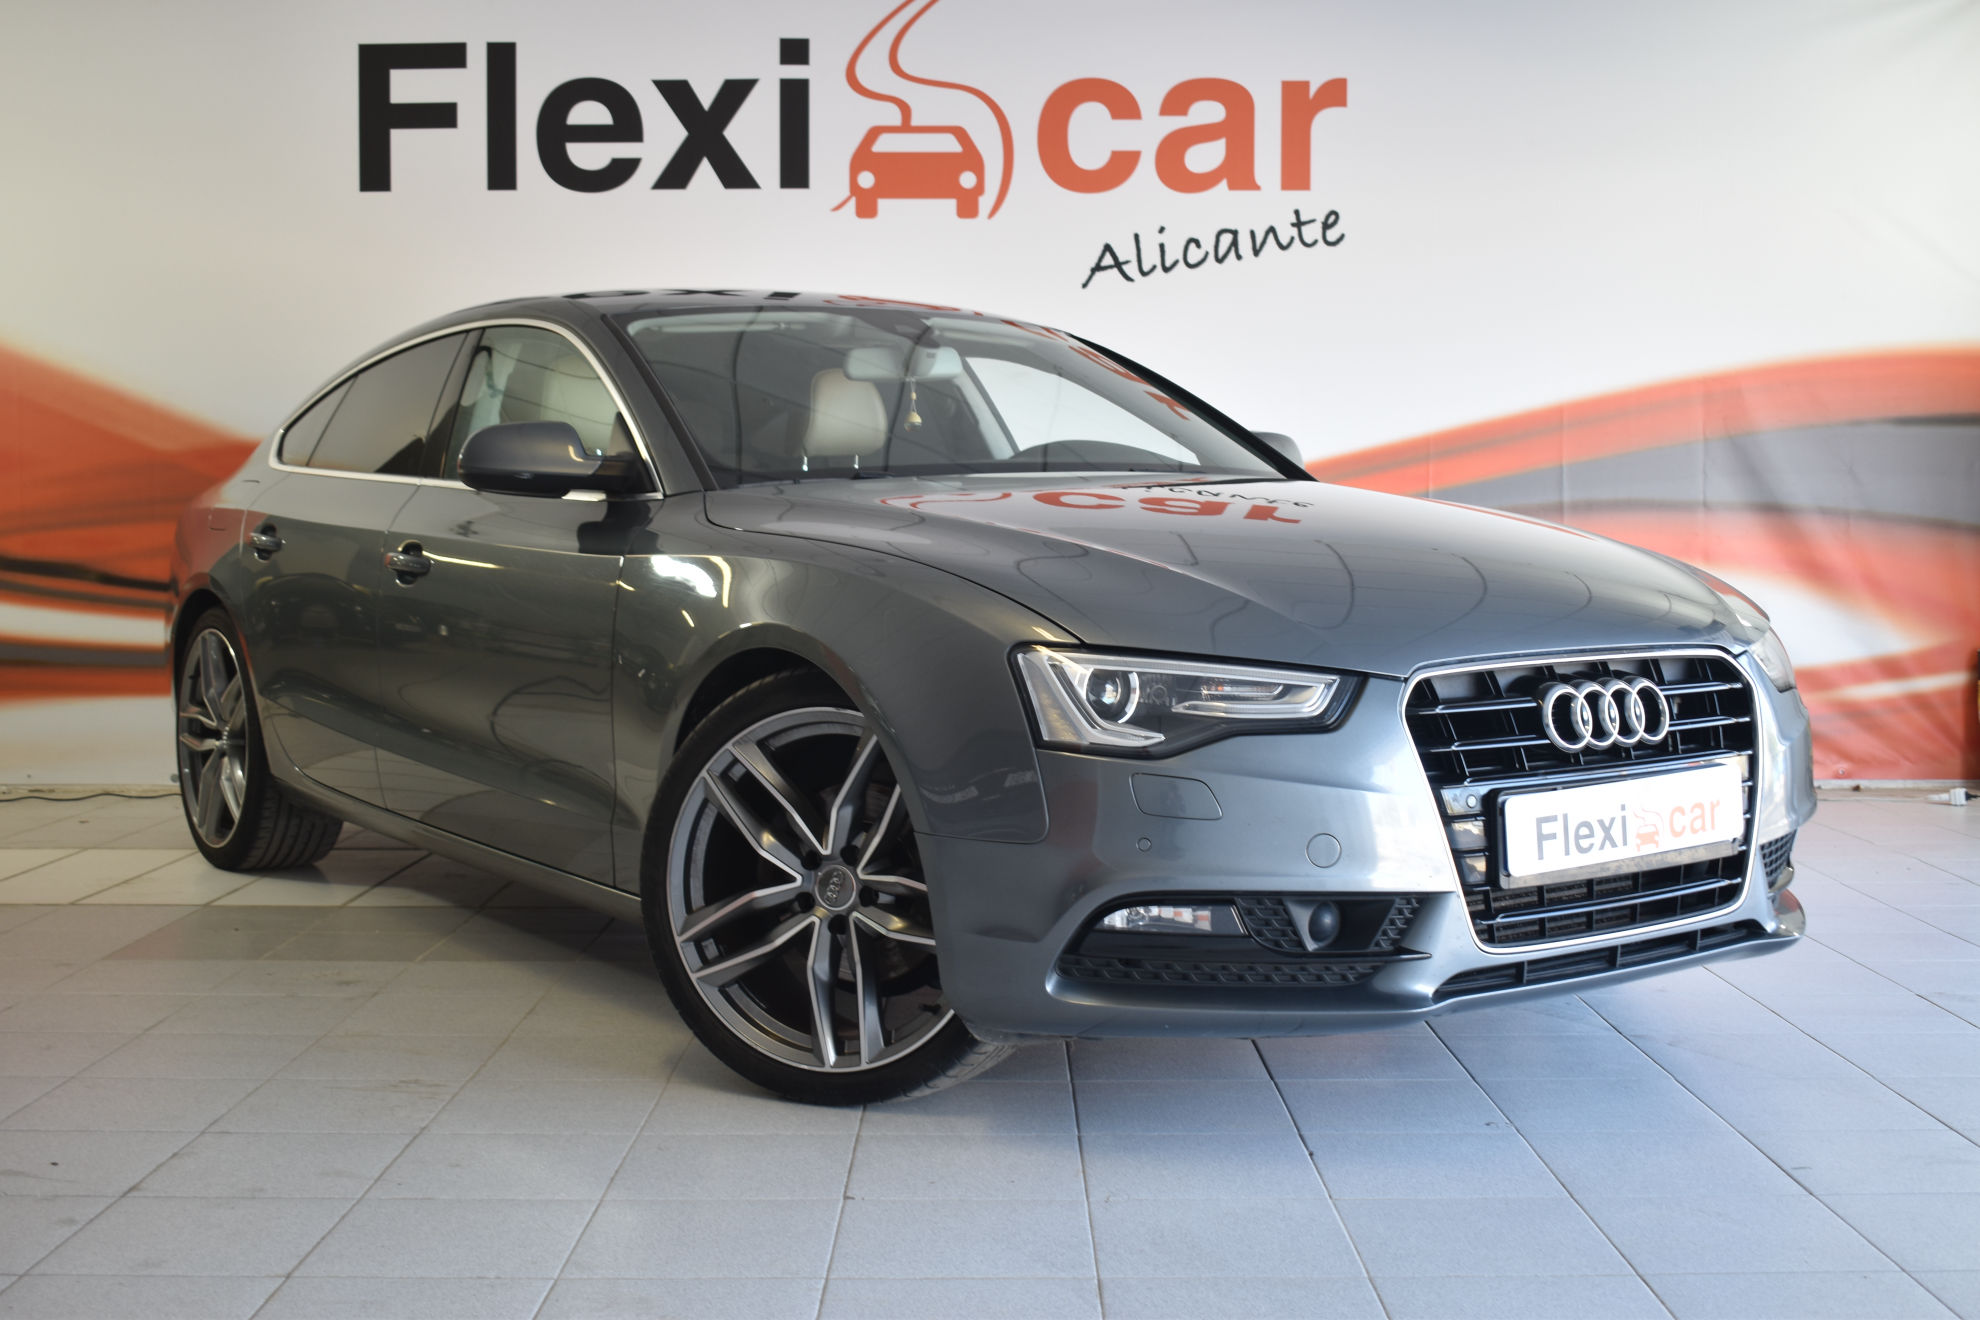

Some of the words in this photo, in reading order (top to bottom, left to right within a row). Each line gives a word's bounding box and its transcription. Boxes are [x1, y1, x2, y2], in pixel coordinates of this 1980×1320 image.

[359, 38, 809, 192] Flexi
[1038, 78, 1347, 193] car
[1082, 209, 1345, 288] Alicante
[1535, 804, 1629, 861] Flexi
[1668, 799, 1721, 838] car
